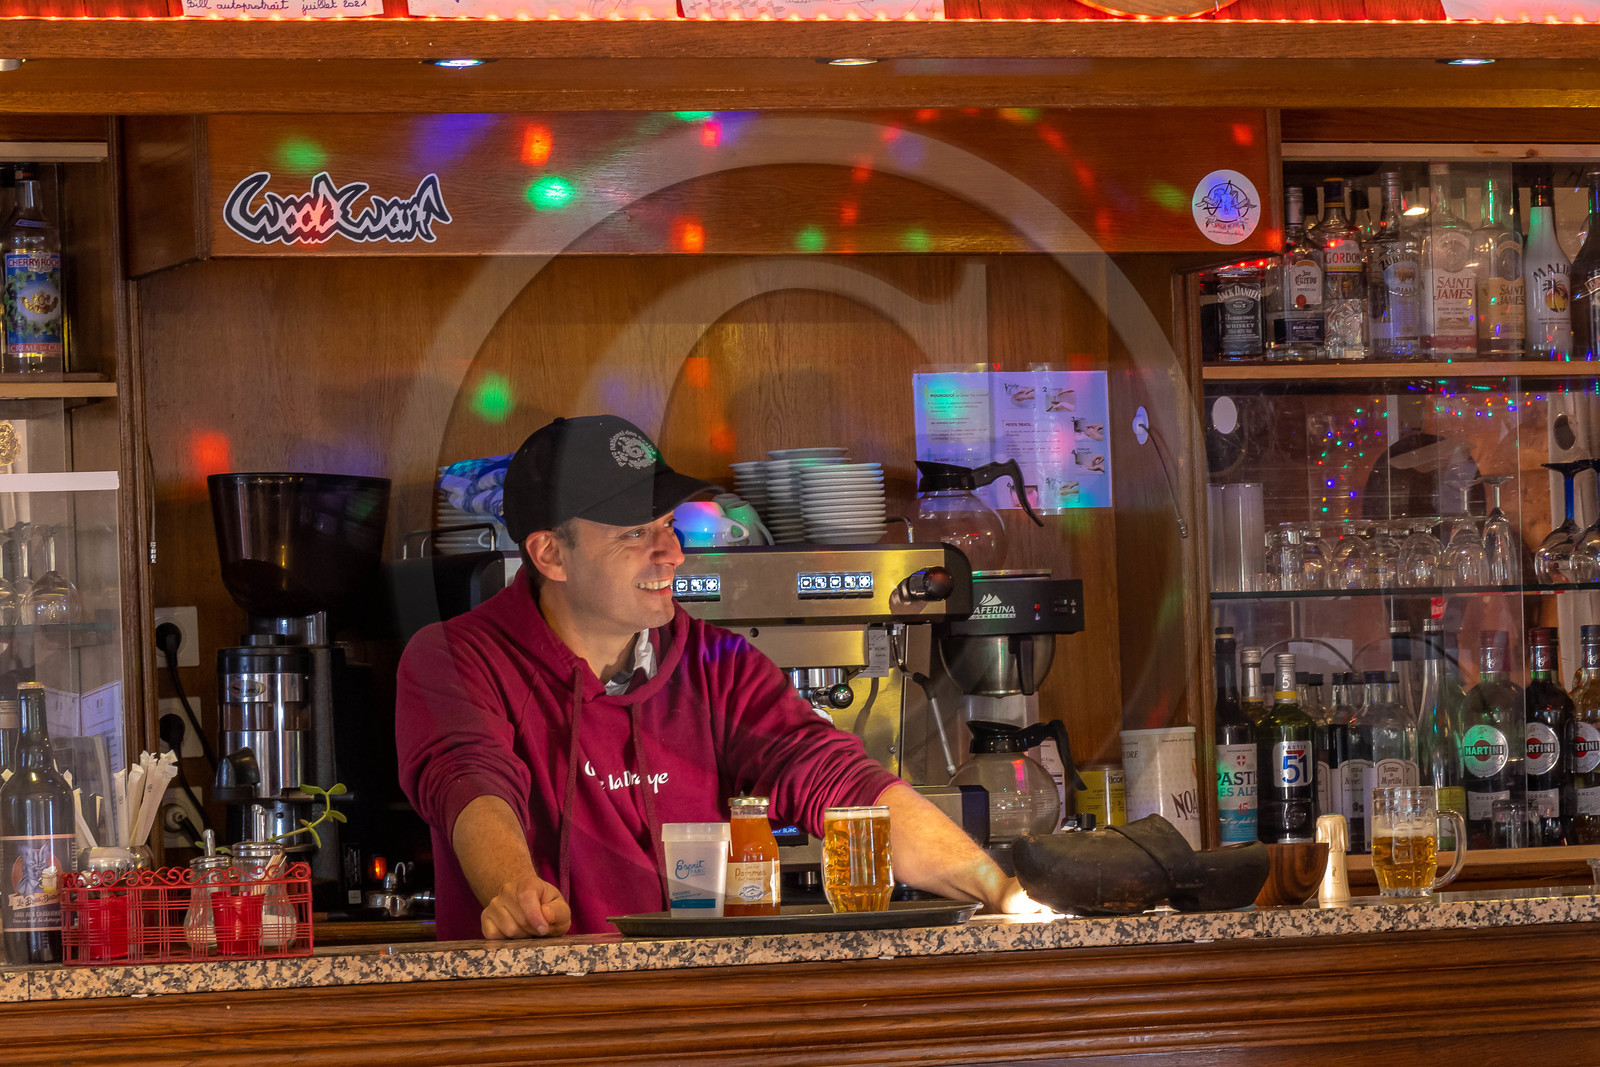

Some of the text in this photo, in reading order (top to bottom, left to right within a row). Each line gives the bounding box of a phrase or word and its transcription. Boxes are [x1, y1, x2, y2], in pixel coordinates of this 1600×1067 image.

[7, 258, 39, 268] CHERRY
[1437, 277, 1472, 289] SAINT
[1217, 285, 1262, 303] JACK DANIEL'S
[1434, 289, 1473, 301] JAMES
[972, 605, 1015, 615] AFERINA
[1465, 745, 1504, 755] MARTINI
[1526, 743, 1556, 752] ARTINI
[1575, 741, 1599, 751] RTINI
[1282, 754, 1307, 784] 51
[1238, 802, 1249, 815] 45
[735, 867, 767, 880] Pommes
